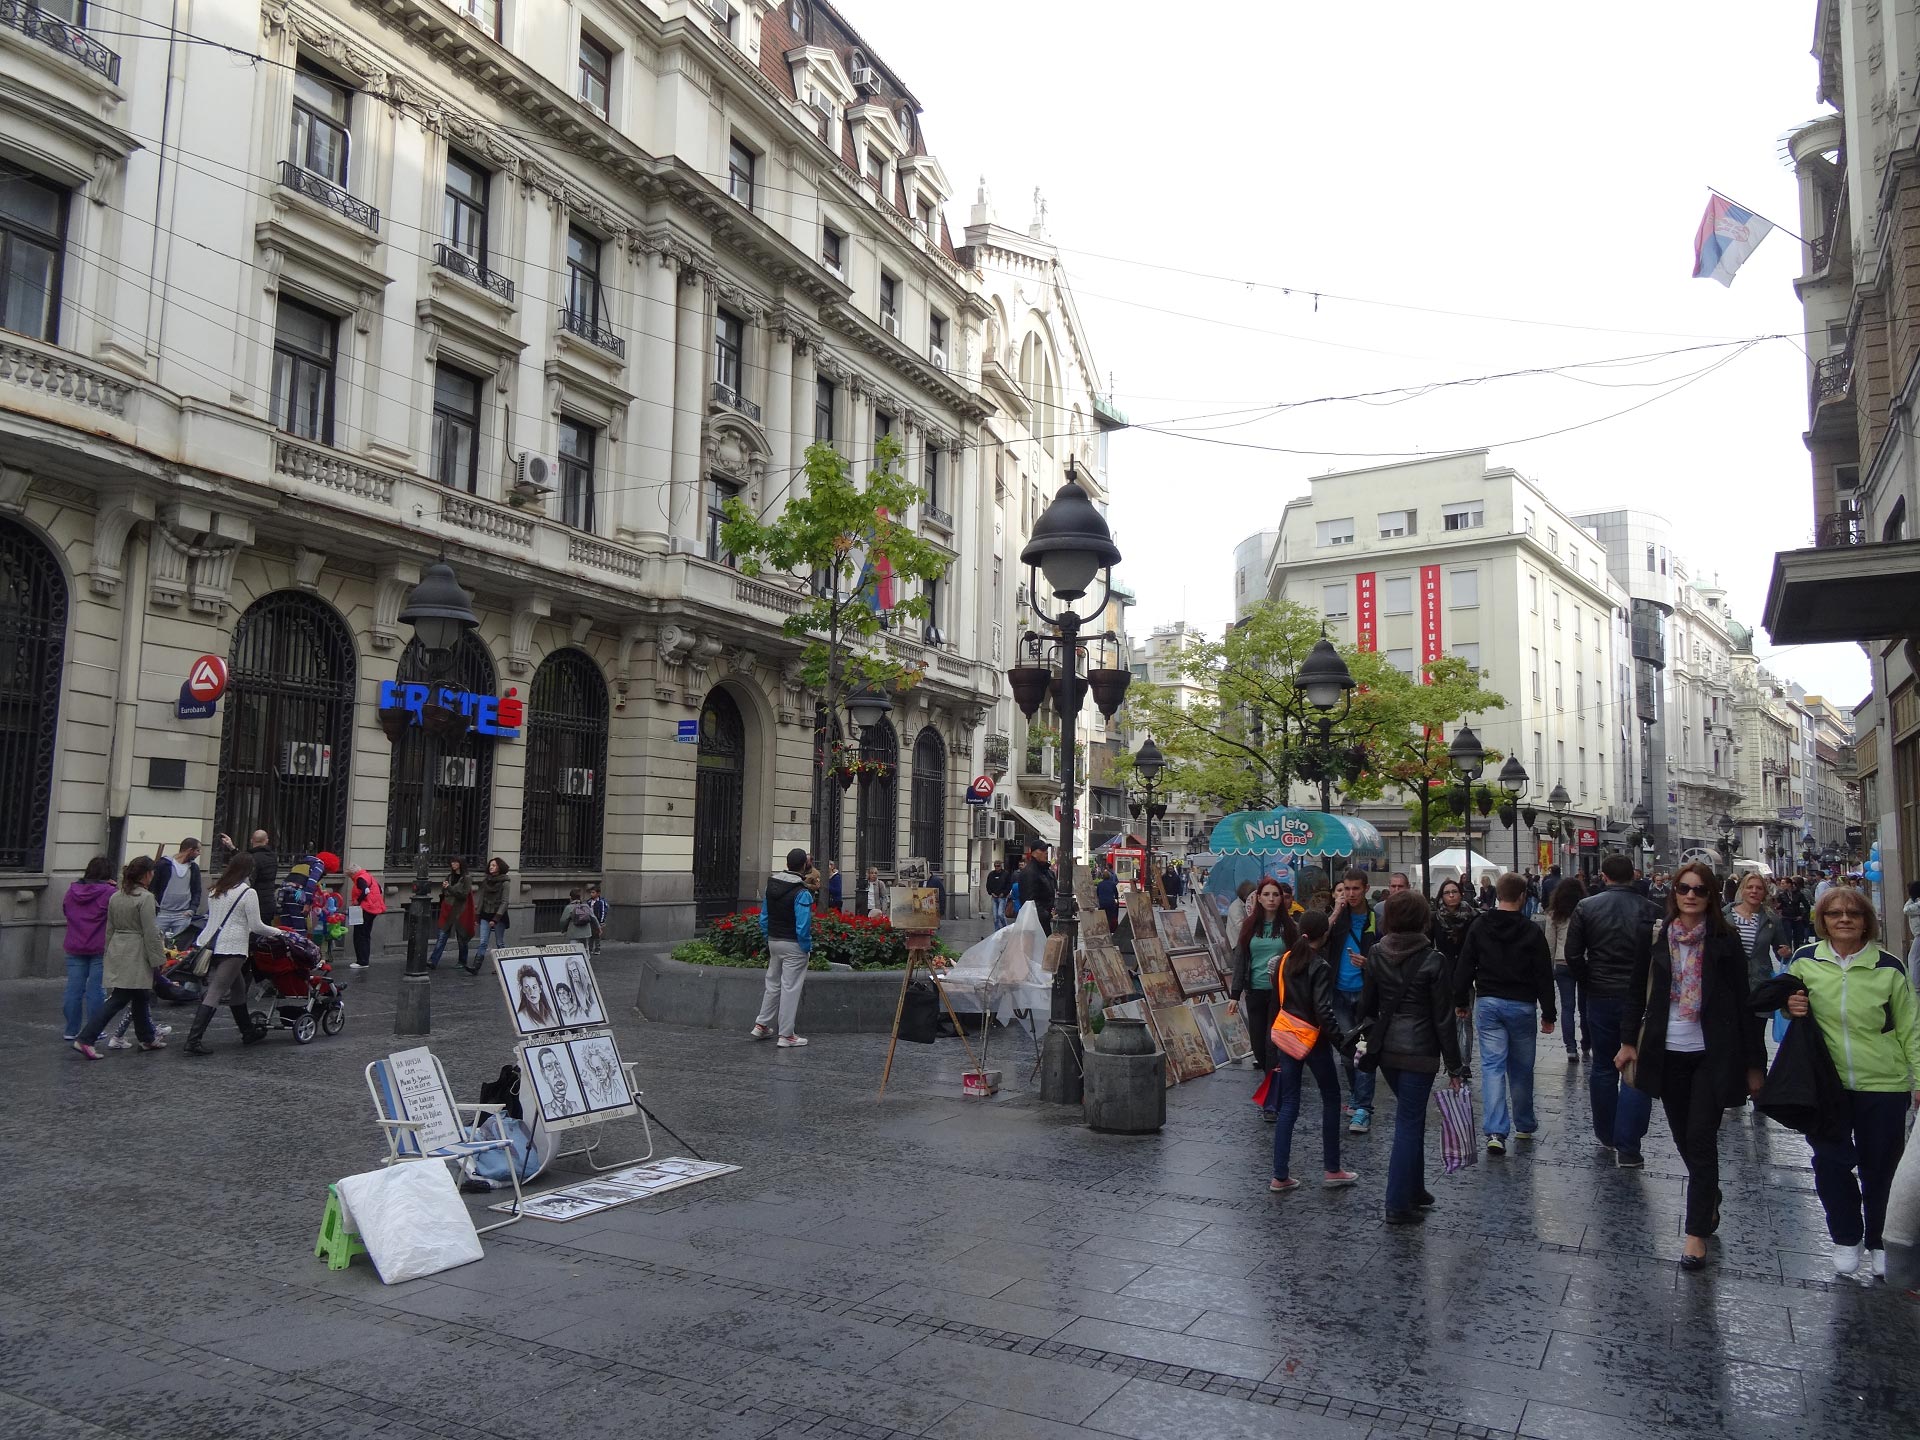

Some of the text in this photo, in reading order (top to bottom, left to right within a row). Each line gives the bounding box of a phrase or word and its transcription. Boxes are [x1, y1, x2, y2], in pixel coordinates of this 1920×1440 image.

[1427, 570, 1436, 661] Instituto
[495, 948, 530, 958] ПОРТРЕТ
[540, 945, 577, 955] PORTRAIT
[568, 1118, 575, 1127] 5
[582, 1114, 591, 1124] 10
